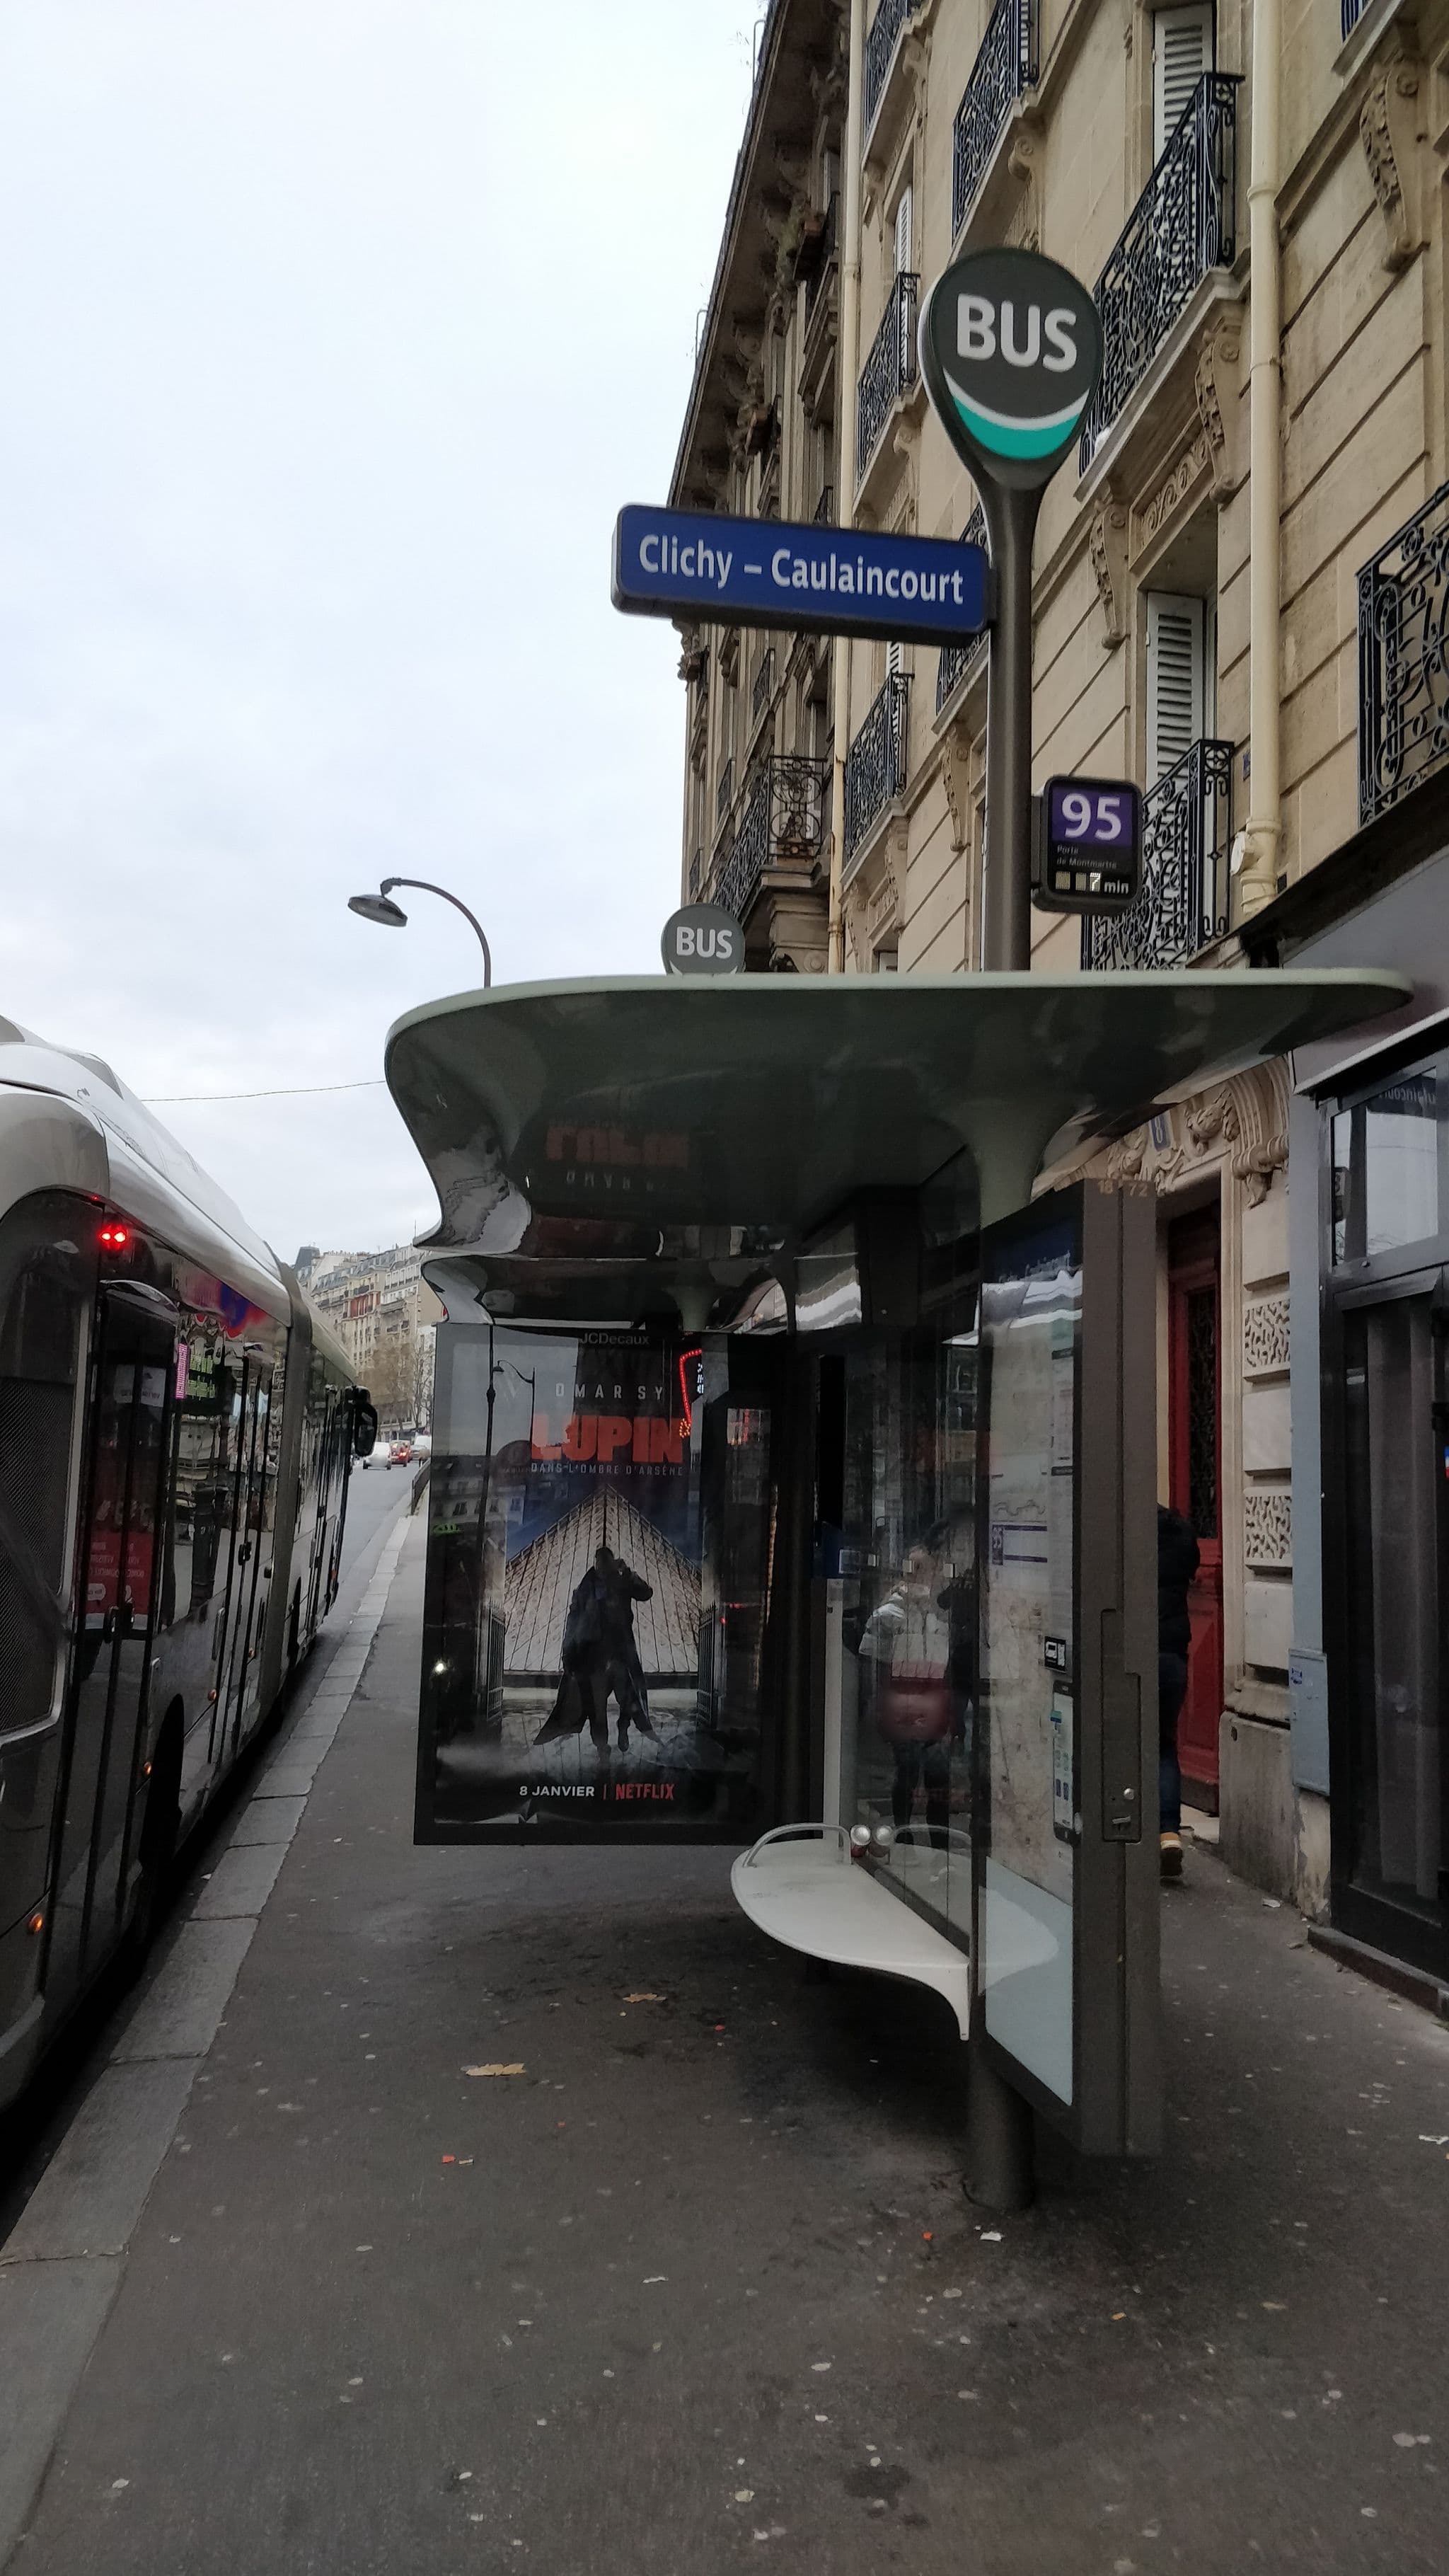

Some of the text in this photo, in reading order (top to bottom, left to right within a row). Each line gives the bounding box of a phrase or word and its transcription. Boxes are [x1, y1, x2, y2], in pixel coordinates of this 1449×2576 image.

[956, 293, 1078, 373] BUS
[639, 534, 733, 589] Clichy
[770, 548, 965, 605] Caulaincourt
[1062, 793, 1122, 841] 95
[1090, 872, 1129, 894] 7 min
[676, 926, 733, 960] BUS
[581, 1332, 650, 1345] JCDecaux
[555, 1382, 664, 1401] OMAR SY
[531, 1413, 684, 1464] LUPIN
[531, 1462, 562, 1473] DANS
[568, 1462, 620, 1474] L'OMBRE
[519, 1783, 675, 1800] 8 JANVIER NETFLIX
